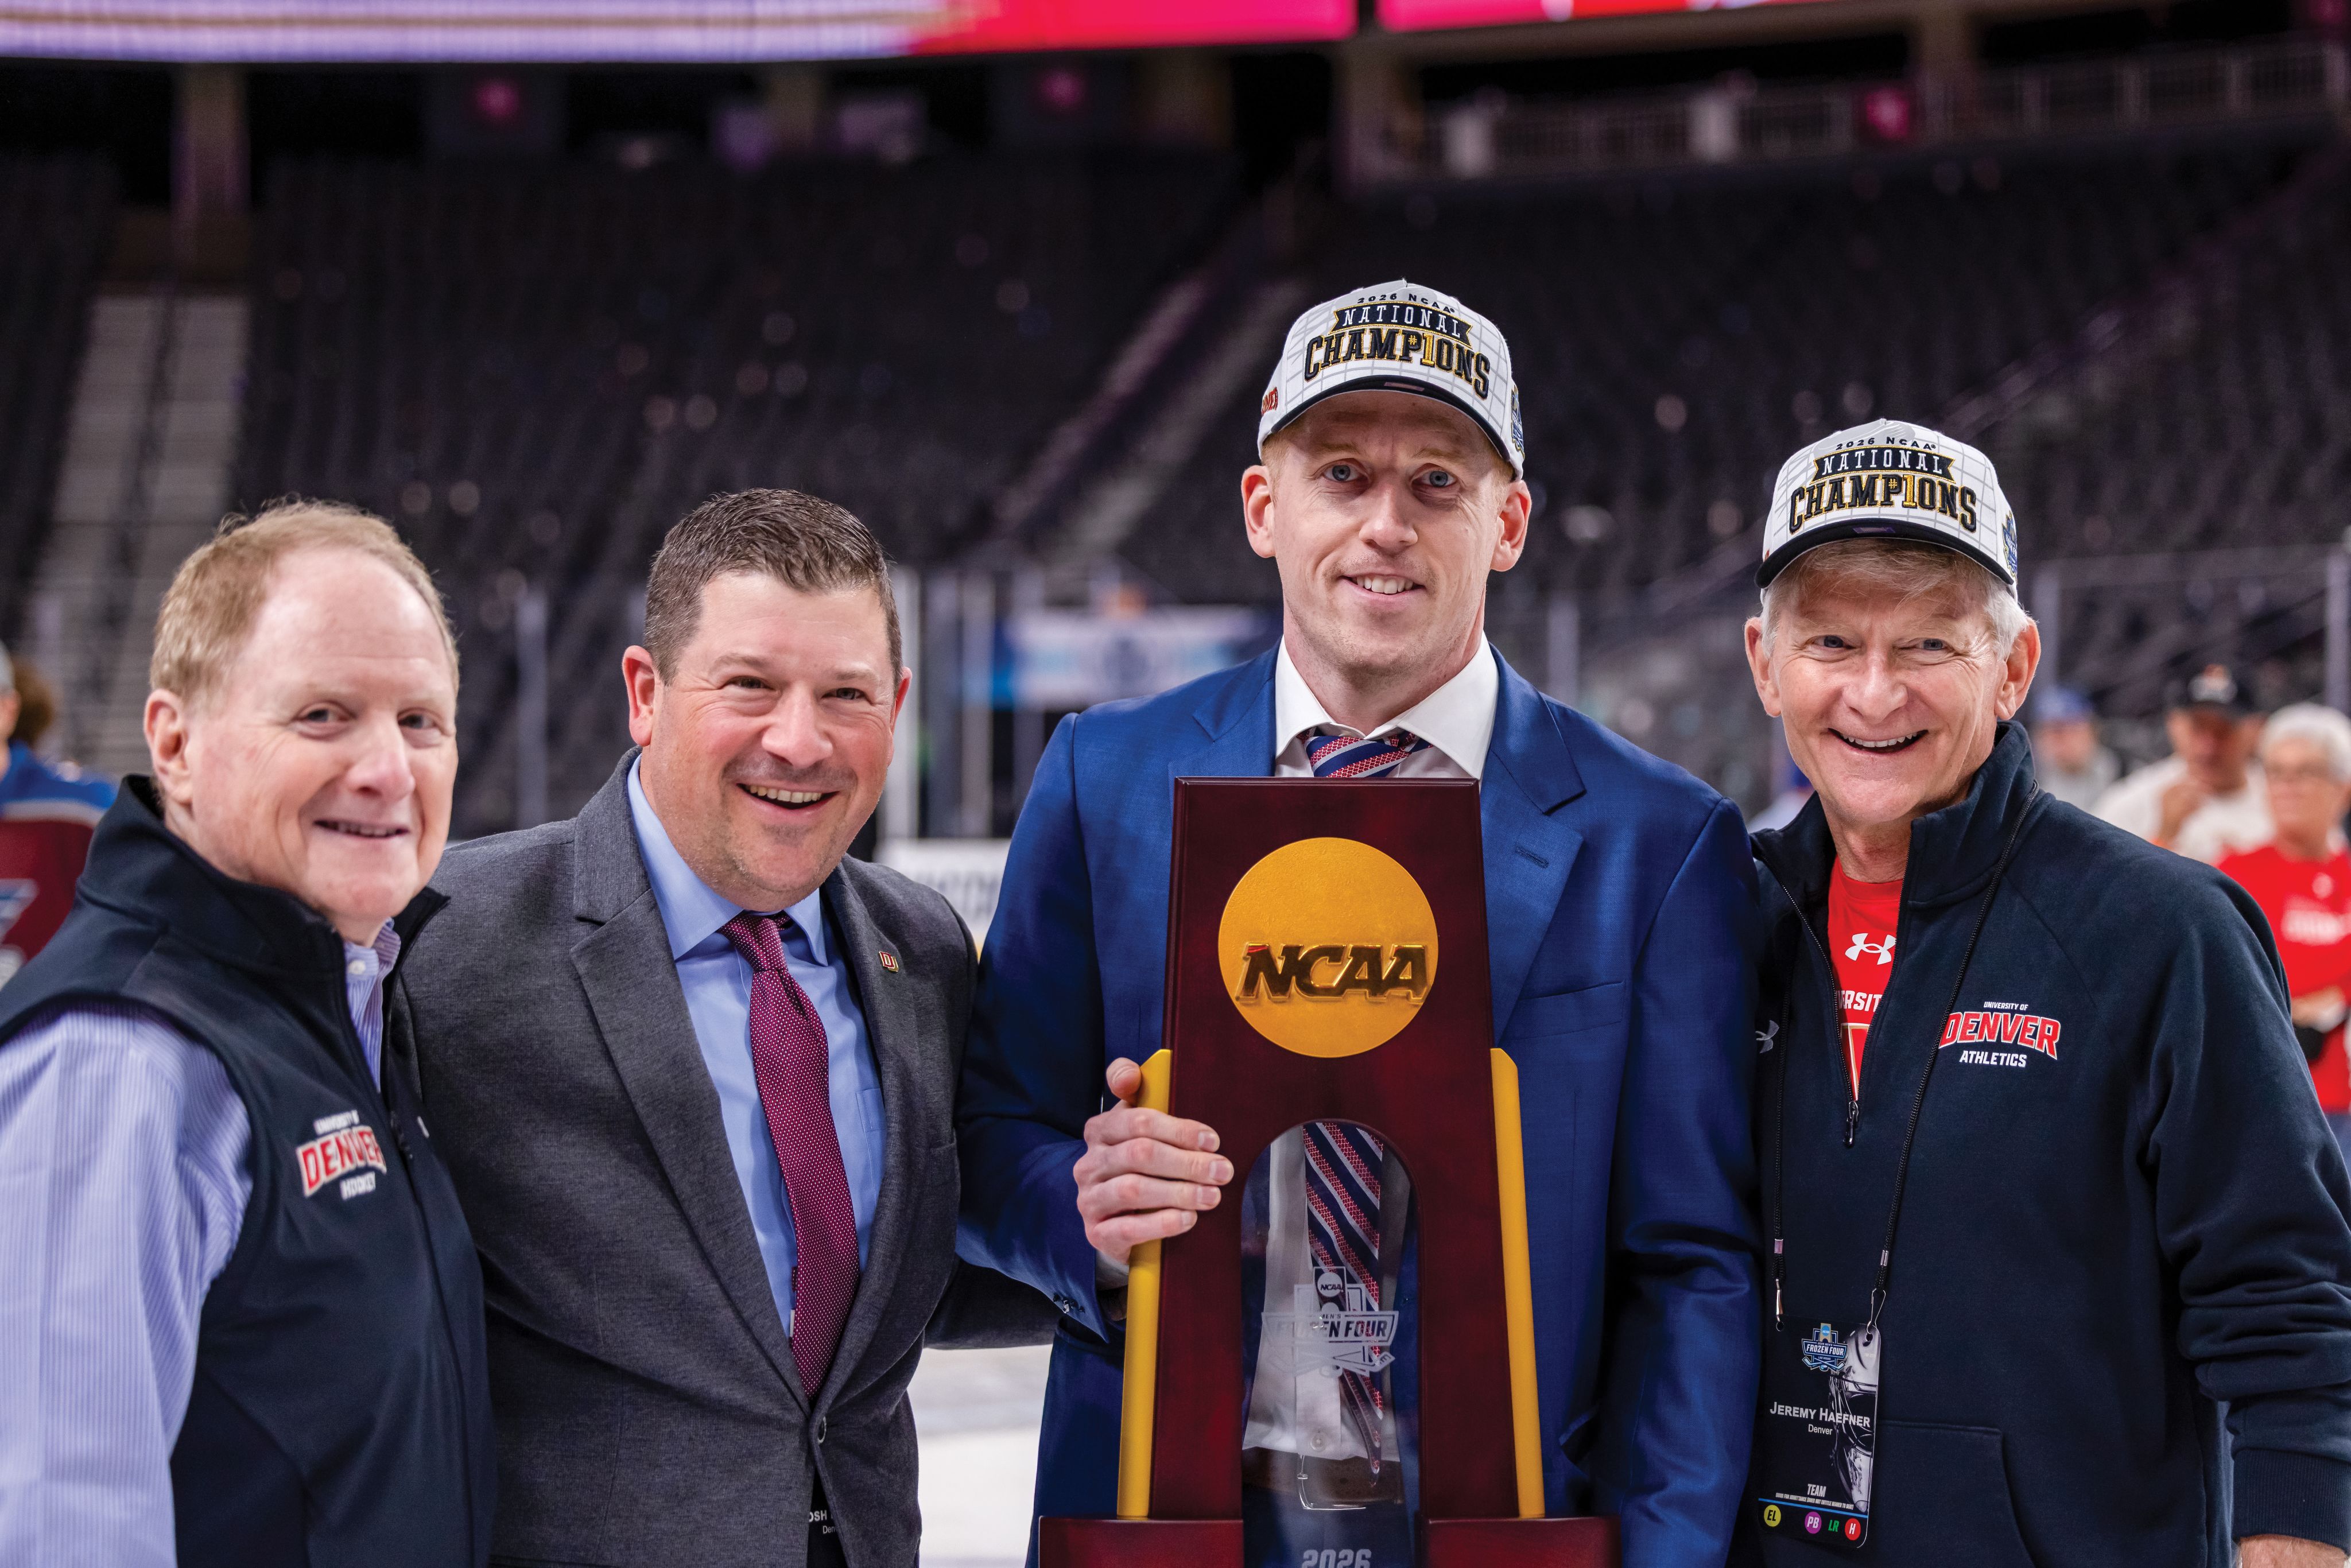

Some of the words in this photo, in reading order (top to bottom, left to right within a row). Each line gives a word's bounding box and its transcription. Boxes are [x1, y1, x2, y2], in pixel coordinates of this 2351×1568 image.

[1357, 293, 1397, 304] 2026
[1343, 305, 1461, 338] NATIONAL
[1836, 437, 1875, 451] 2026
[1822, 449, 1943, 475] NATIONAL
[1235, 942, 1430, 1003] NCAA
[1984, 1001, 2019, 1010] UNIVERSITY
[1938, 1011, 2061, 1061] DENVER
[1959, 1050, 2028, 1068] ATHLETICS
[1344, 1321, 1388, 1338] FOUR
[1806, 1344, 1829, 1354] FROZEN
[1829, 1346, 1844, 1356] FOUR
[1808, 1424, 1833, 1435] Denver
[1807, 1483, 1826, 1497] TEAM
[823, 1525, 836, 1534] Den
[1767, 1509, 1776, 1522] EL
[1806, 1516, 1819, 1529] PB
[1828, 1519, 1840, 1532] LR
[1849, 1523, 1856, 1535] H
[1301, 1548, 1372, 1568] 2026
